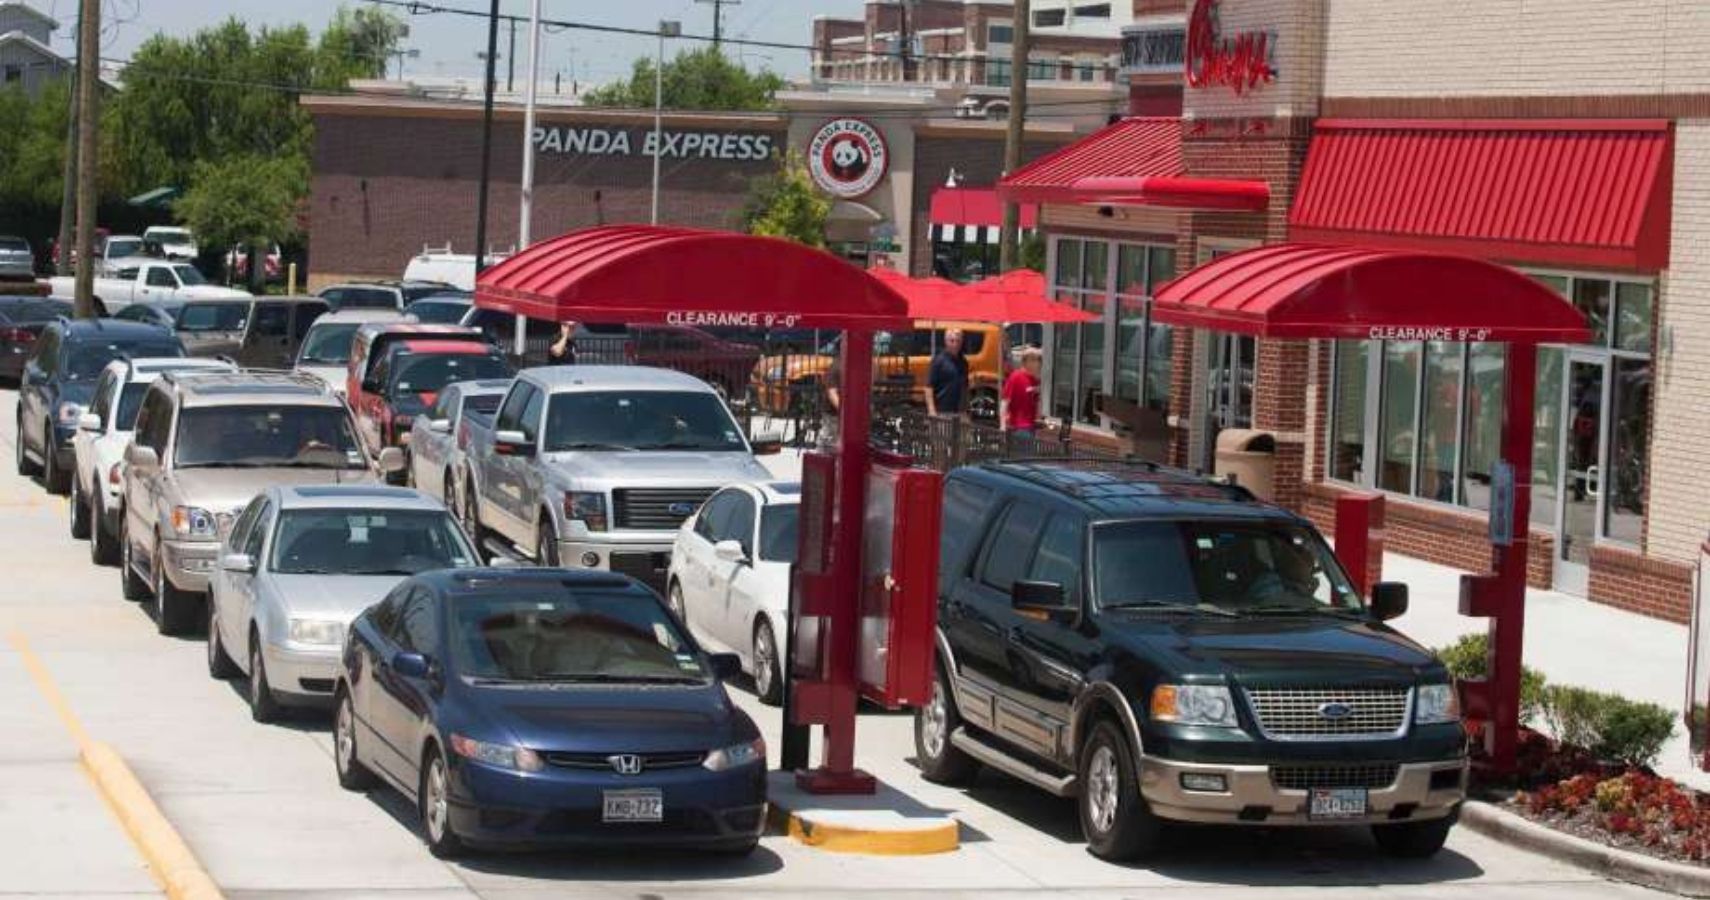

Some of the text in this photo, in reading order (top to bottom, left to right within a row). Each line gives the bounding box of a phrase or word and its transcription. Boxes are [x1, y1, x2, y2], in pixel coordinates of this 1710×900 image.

[530, 127, 771, 160] PANDA EXPRESS
[812, 122, 881, 158] PANDA EXPRESS
[666, 311, 757, 326] CLEARANCE
[1369, 326, 1452, 341] CLEARANCE
